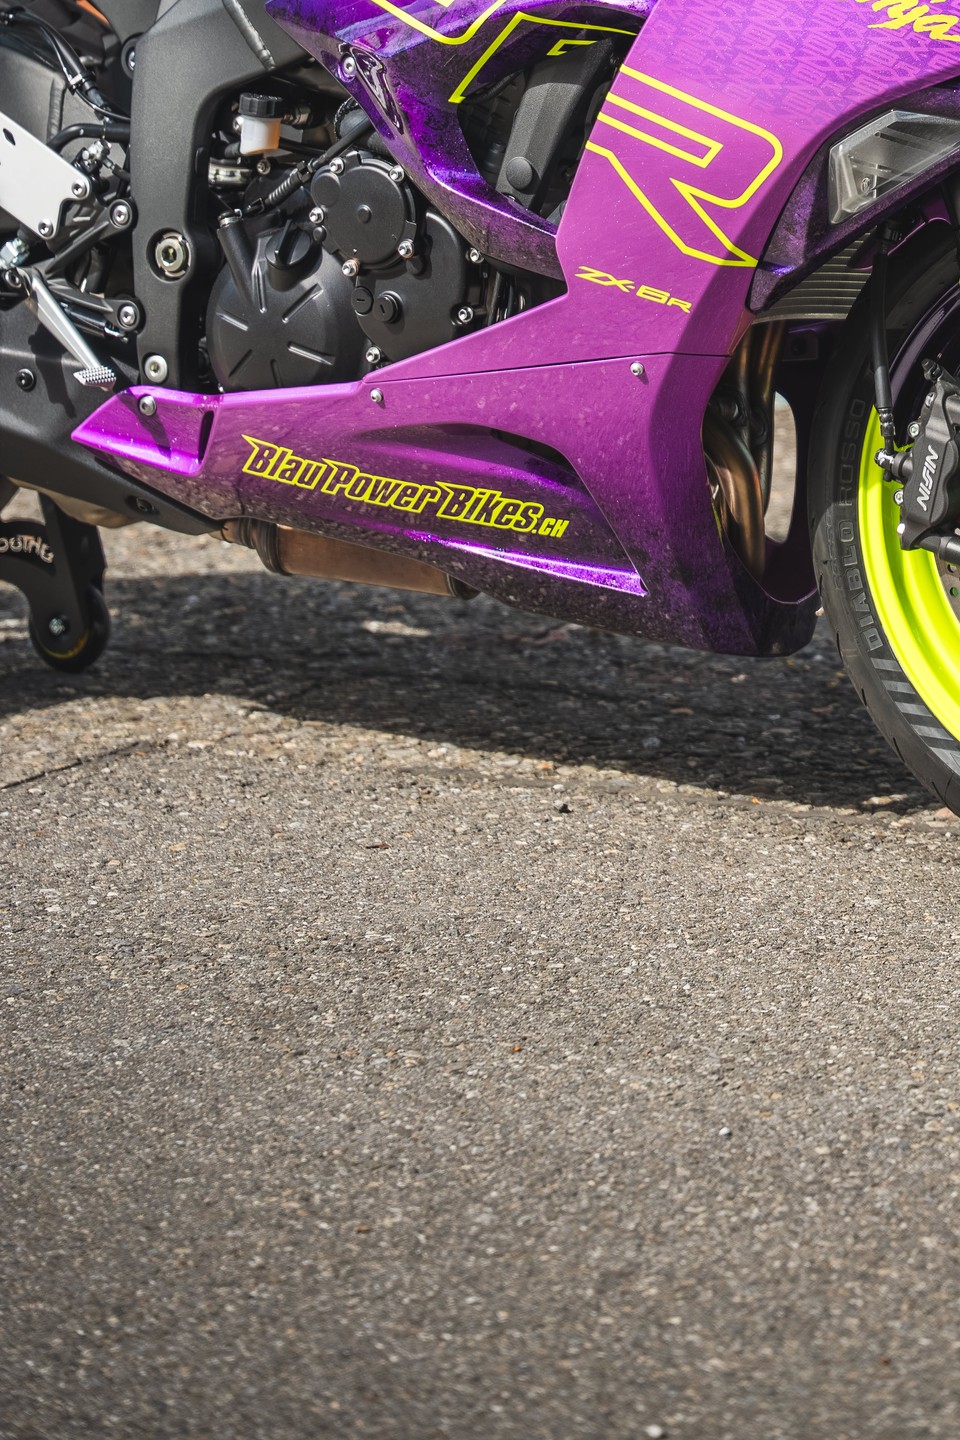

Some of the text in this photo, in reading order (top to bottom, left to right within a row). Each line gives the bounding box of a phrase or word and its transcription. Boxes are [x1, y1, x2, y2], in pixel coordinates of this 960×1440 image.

[574, 265, 693, 314] ZX-6R
[838, 398, 884, 652] DIABLO ROSSO
